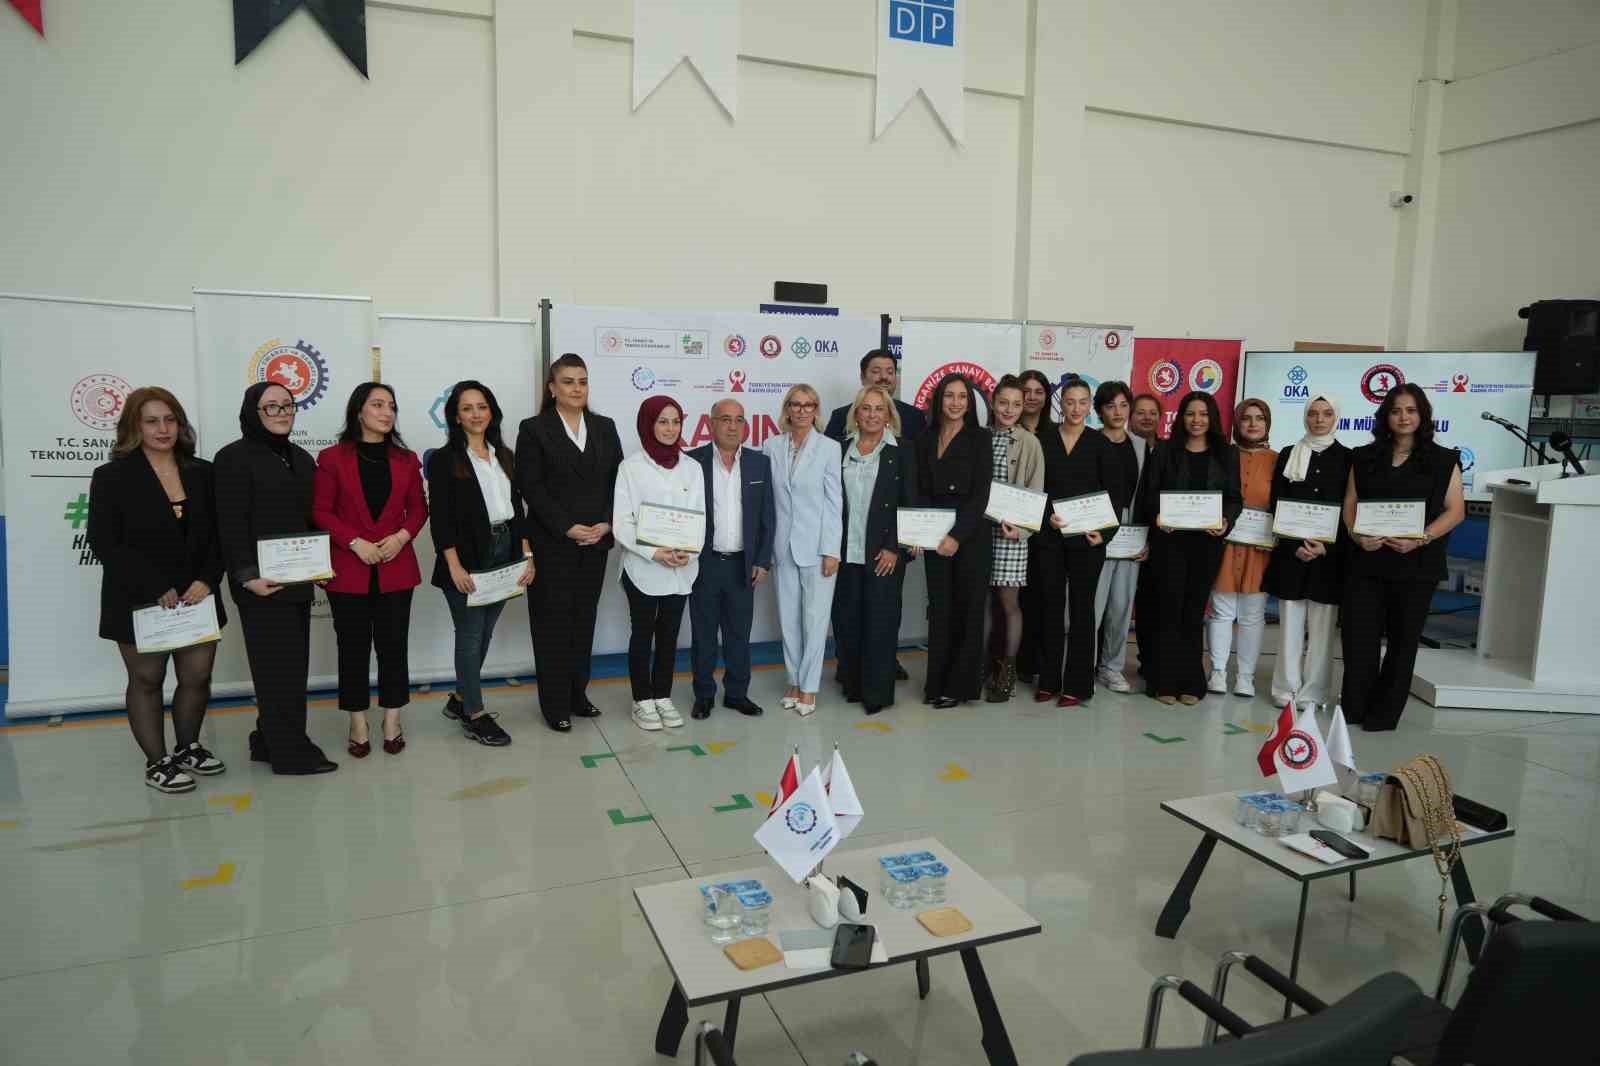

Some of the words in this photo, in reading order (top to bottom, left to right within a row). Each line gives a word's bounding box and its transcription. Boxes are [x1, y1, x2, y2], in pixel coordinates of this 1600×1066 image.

[815, 340, 839, 353] OKA
[1284, 385, 1310, 398] OKA
[56, 438, 80, 447] T.C.
[30, 450, 104, 462] TEKNOLOJİ
